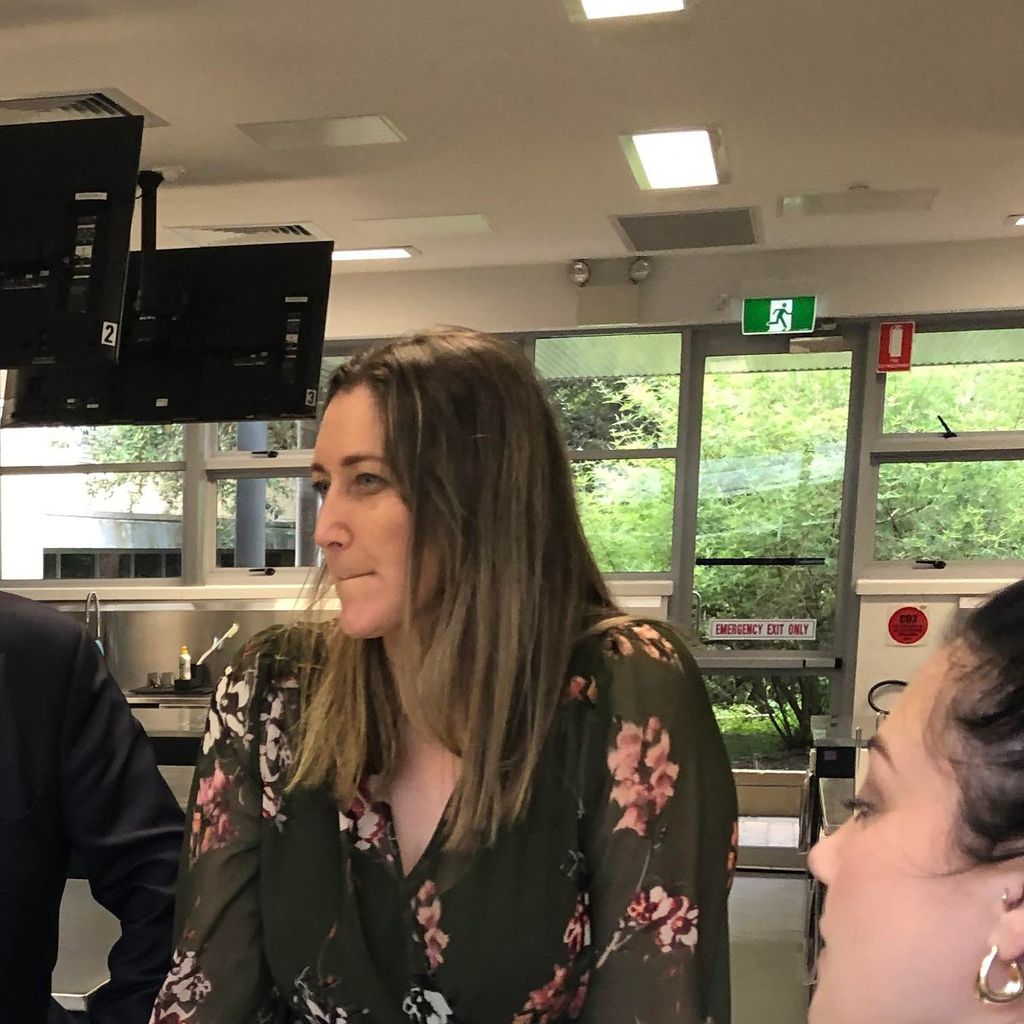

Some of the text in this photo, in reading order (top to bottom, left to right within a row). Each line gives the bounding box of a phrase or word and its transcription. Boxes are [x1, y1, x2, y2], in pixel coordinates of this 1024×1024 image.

[104, 325, 114, 343] 2
[715, 623, 810, 636] EMERGENCY EXIT ONLY
